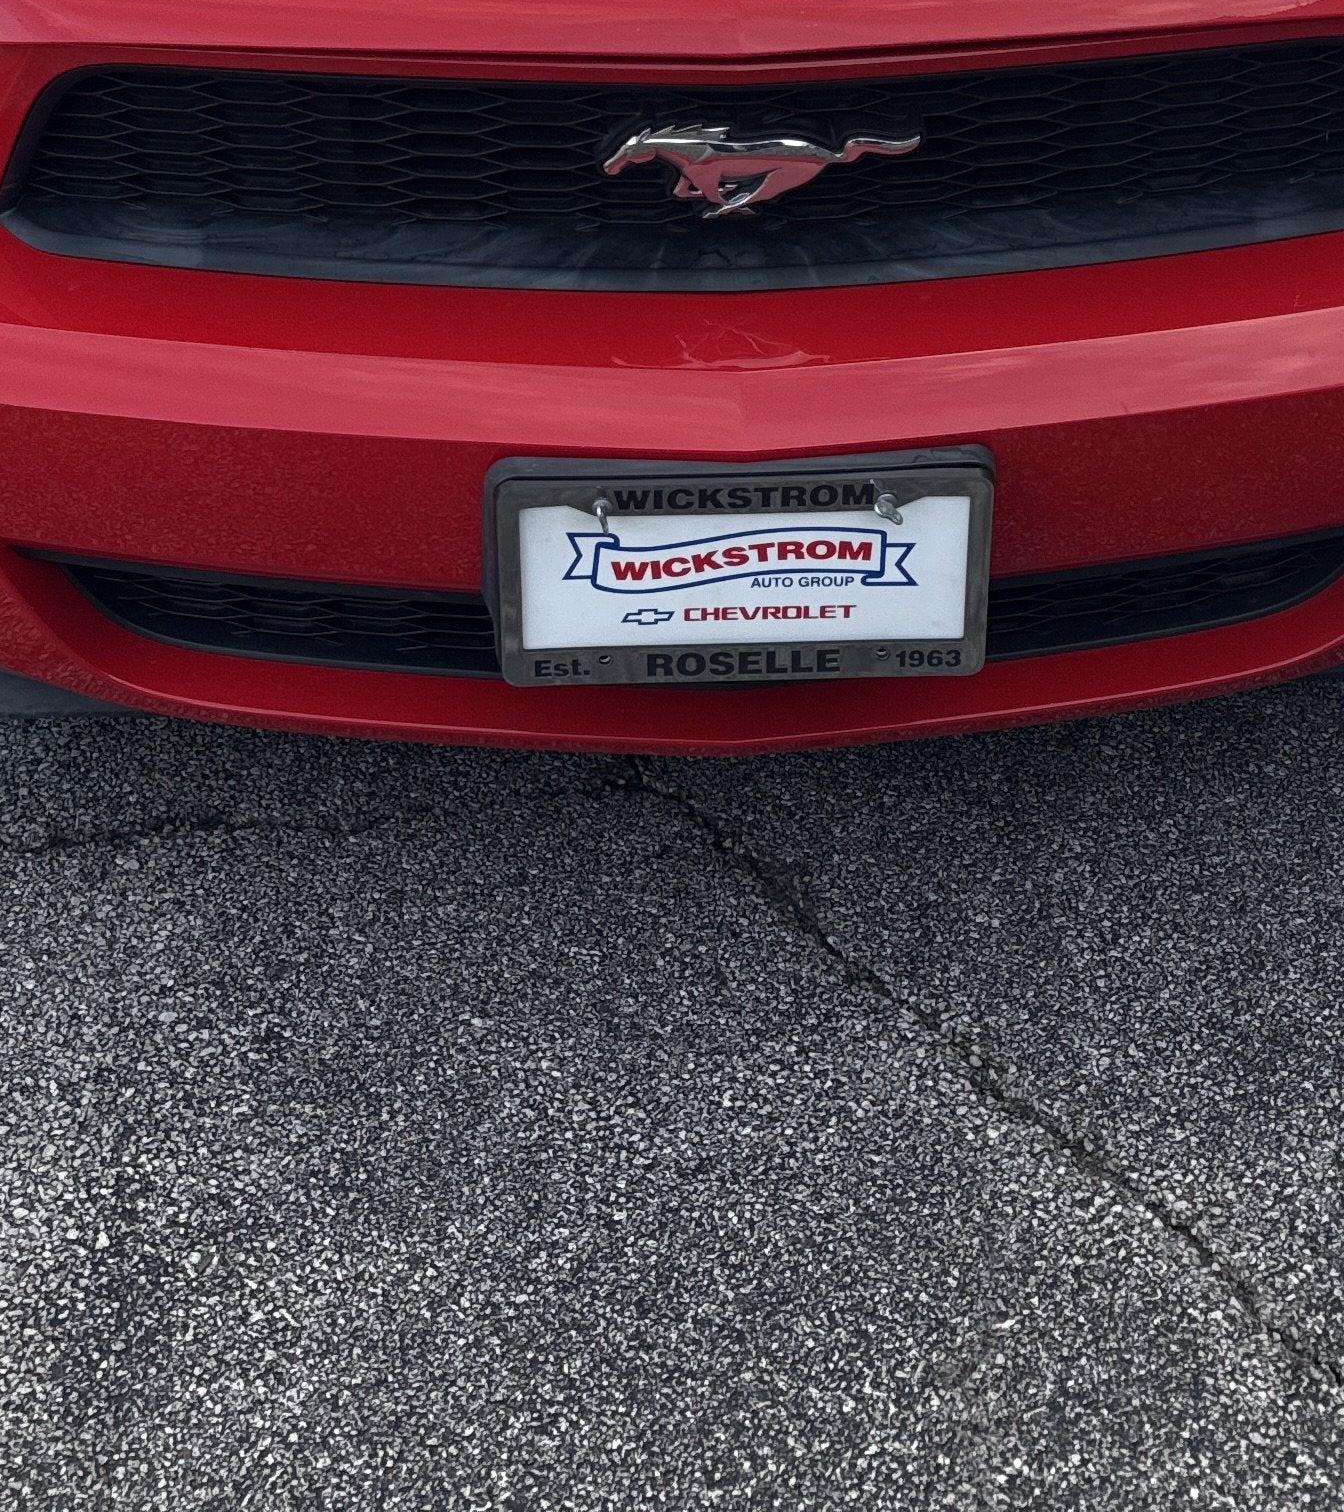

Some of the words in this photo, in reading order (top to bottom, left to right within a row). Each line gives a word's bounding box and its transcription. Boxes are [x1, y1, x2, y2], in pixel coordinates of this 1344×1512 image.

[613, 483, 875, 512] WICKSTROM
[610, 540, 873, 581] WICKSTROM
[750, 576, 794, 589] AUTO
[798, 575, 855, 588] GROUP
[682, 604, 858, 622] CHEVROLET
[533, 658, 591, 678] Est.
[646, 649, 842, 678] ROSELLE
[895, 649, 962, 669] 1963
